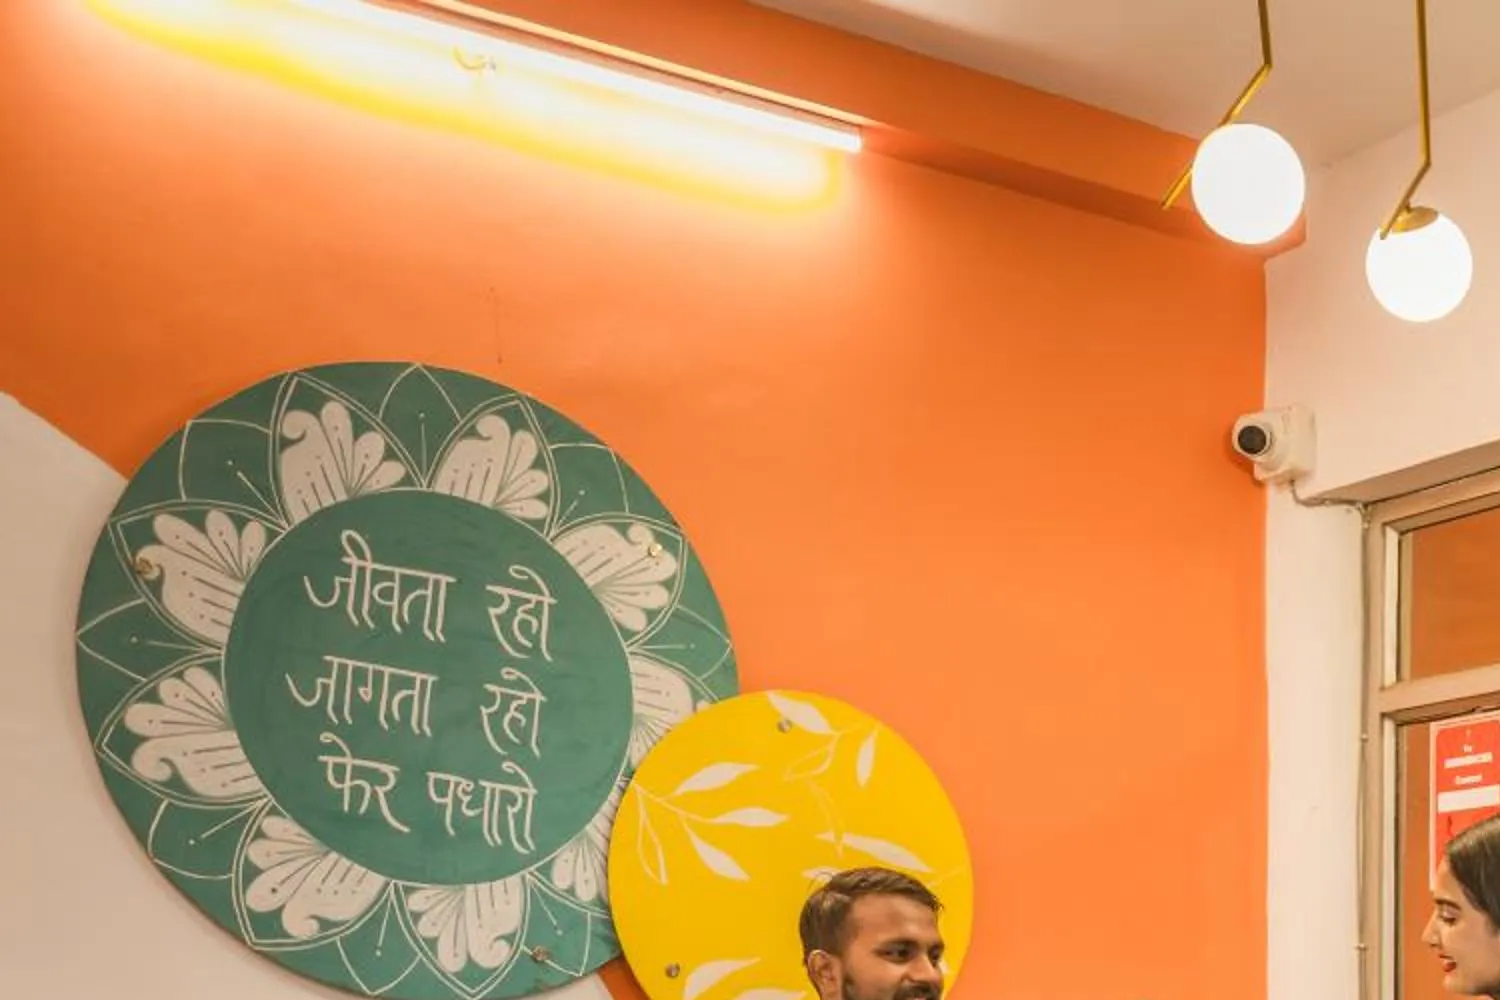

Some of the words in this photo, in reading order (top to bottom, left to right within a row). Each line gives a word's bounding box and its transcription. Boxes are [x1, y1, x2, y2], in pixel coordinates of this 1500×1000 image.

[303, 529, 455, 643] जीवता
[486, 564, 556, 662] रहो
[285, 655, 438, 736] जागता
[480, 669, 549, 756] रहो
[318, 731, 411, 834] फेर
[427, 762, 538, 854] पधारो
